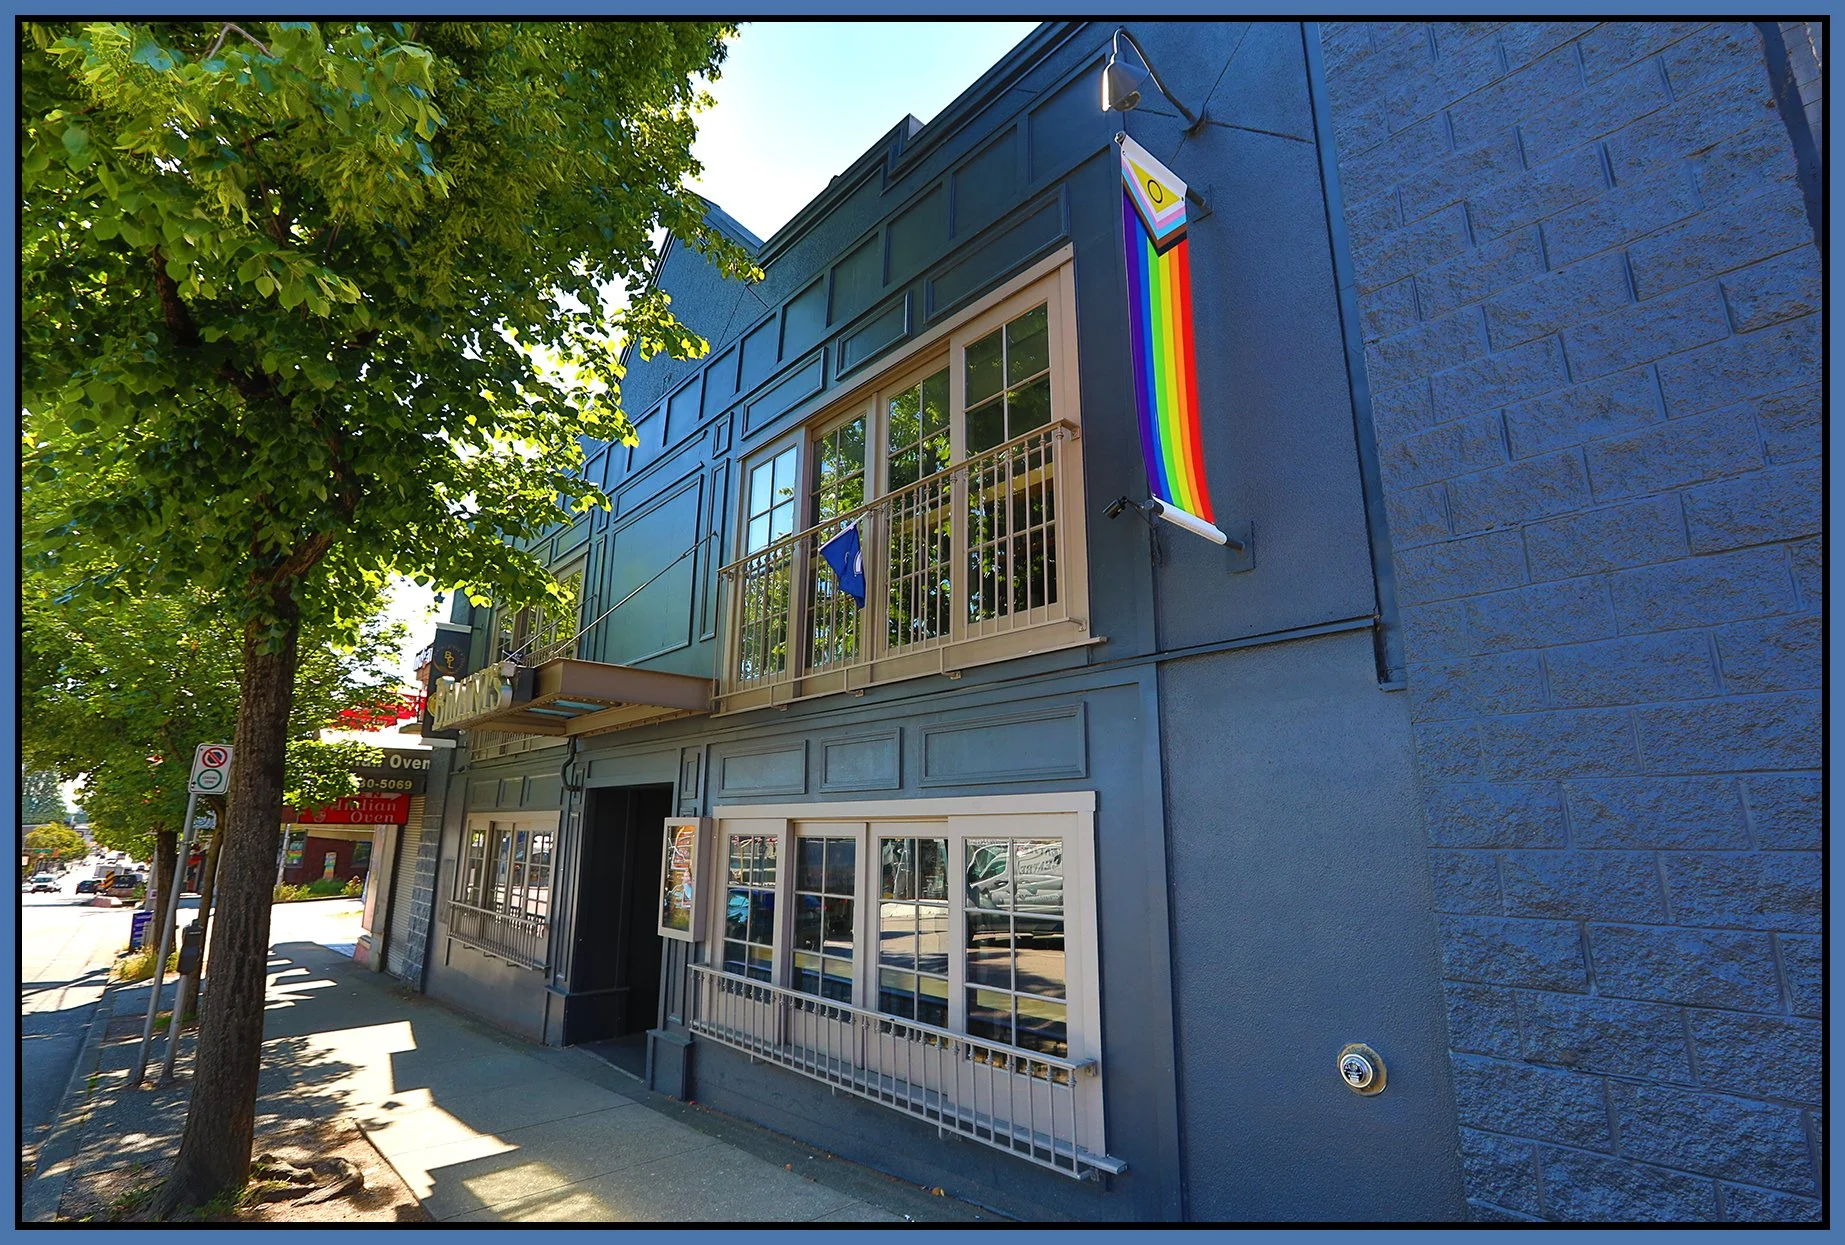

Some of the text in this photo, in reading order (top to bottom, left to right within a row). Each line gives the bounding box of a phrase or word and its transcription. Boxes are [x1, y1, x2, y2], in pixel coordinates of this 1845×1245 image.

[389, 754, 431, 770] Oven
[359, 779, 413, 790] 30-5069
[350, 811, 394, 823] Oven
